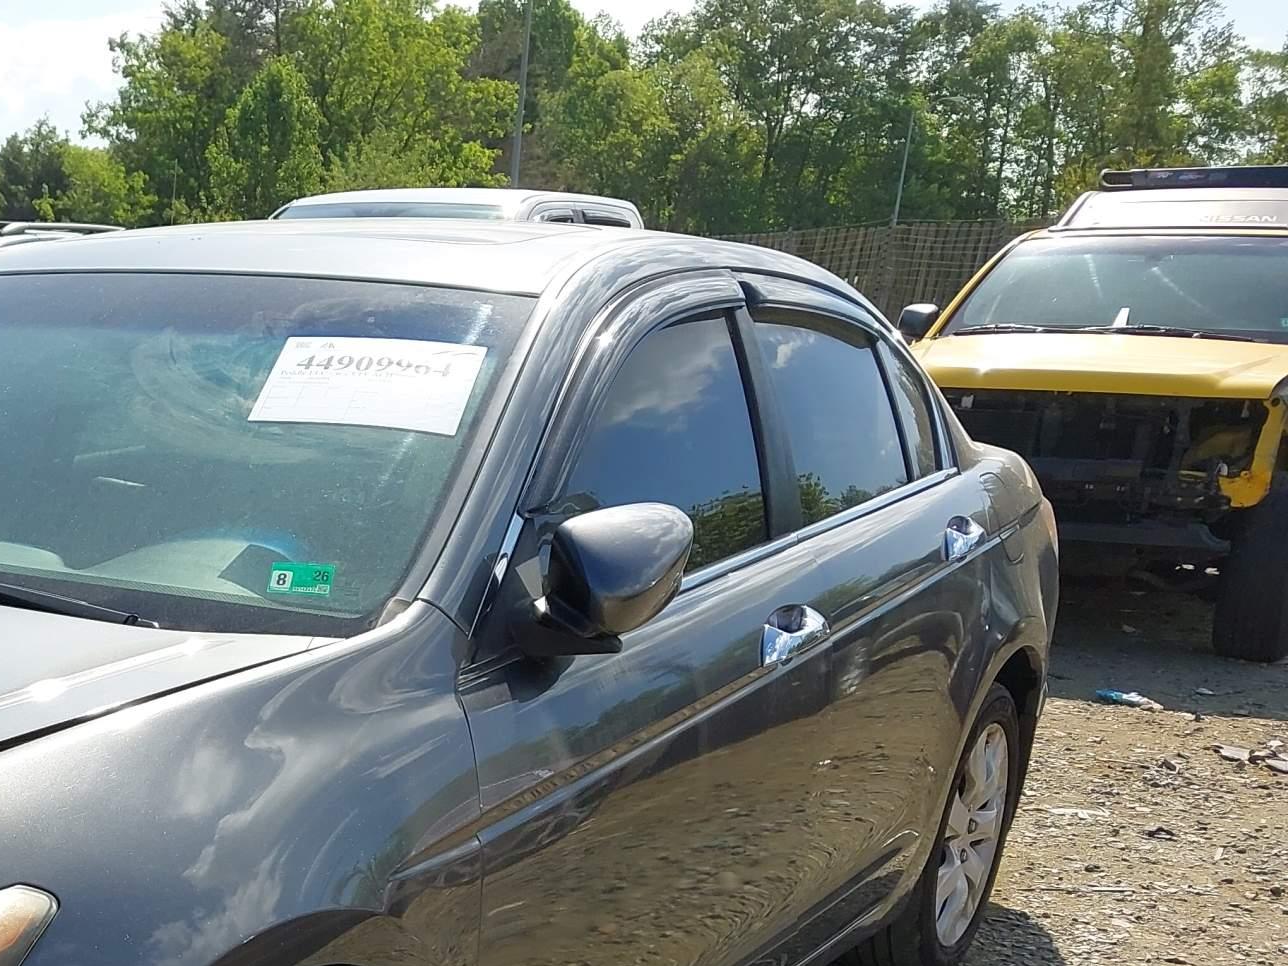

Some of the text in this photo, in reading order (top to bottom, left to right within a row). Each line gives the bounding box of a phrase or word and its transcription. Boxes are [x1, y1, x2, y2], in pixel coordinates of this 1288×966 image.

[1199, 214, 1278, 224] NISSAN
[276, 573, 287, 586] 8
[313, 570, 329, 582] 26
